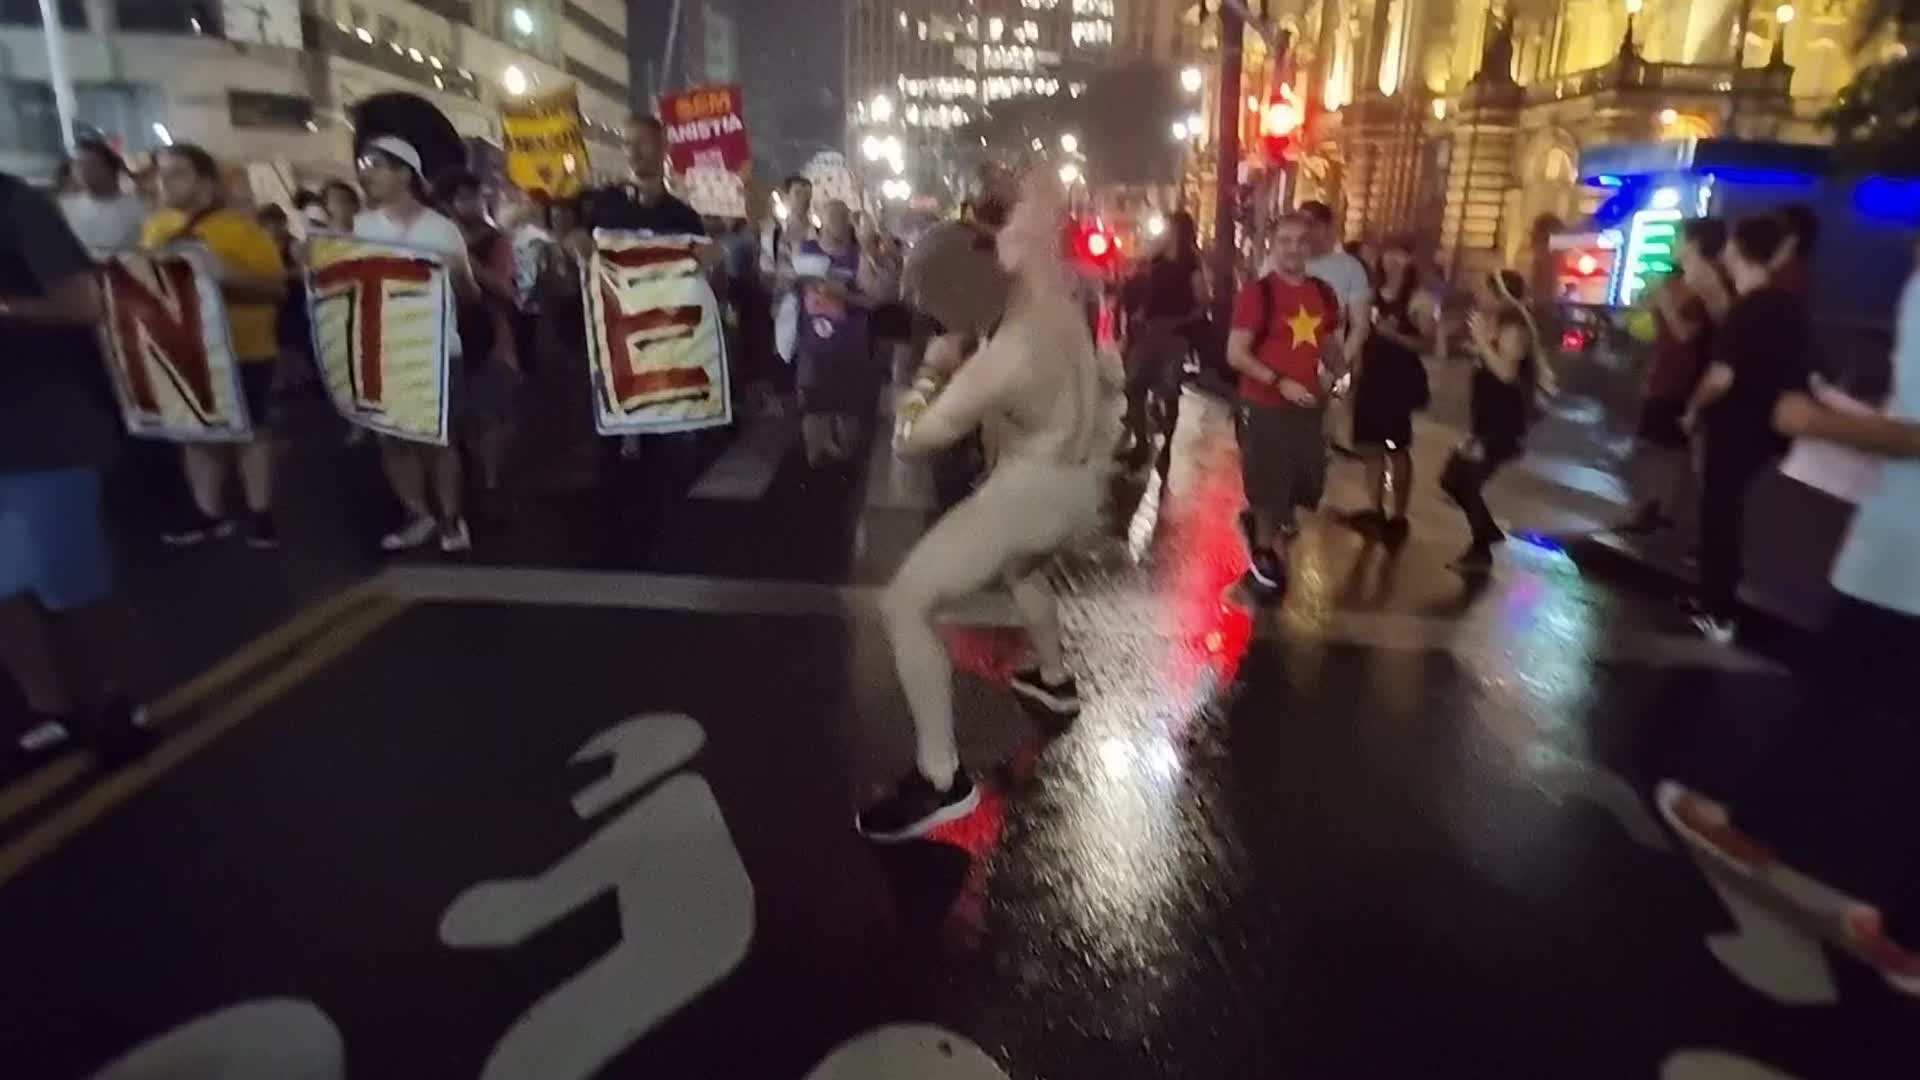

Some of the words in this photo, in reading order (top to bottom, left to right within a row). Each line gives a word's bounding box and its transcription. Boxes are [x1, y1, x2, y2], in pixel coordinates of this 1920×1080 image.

[667, 112, 744, 143] ANISTIA
[99, 253, 218, 420] N
[314, 256, 436, 406] T
[599, 247, 711, 403] E
